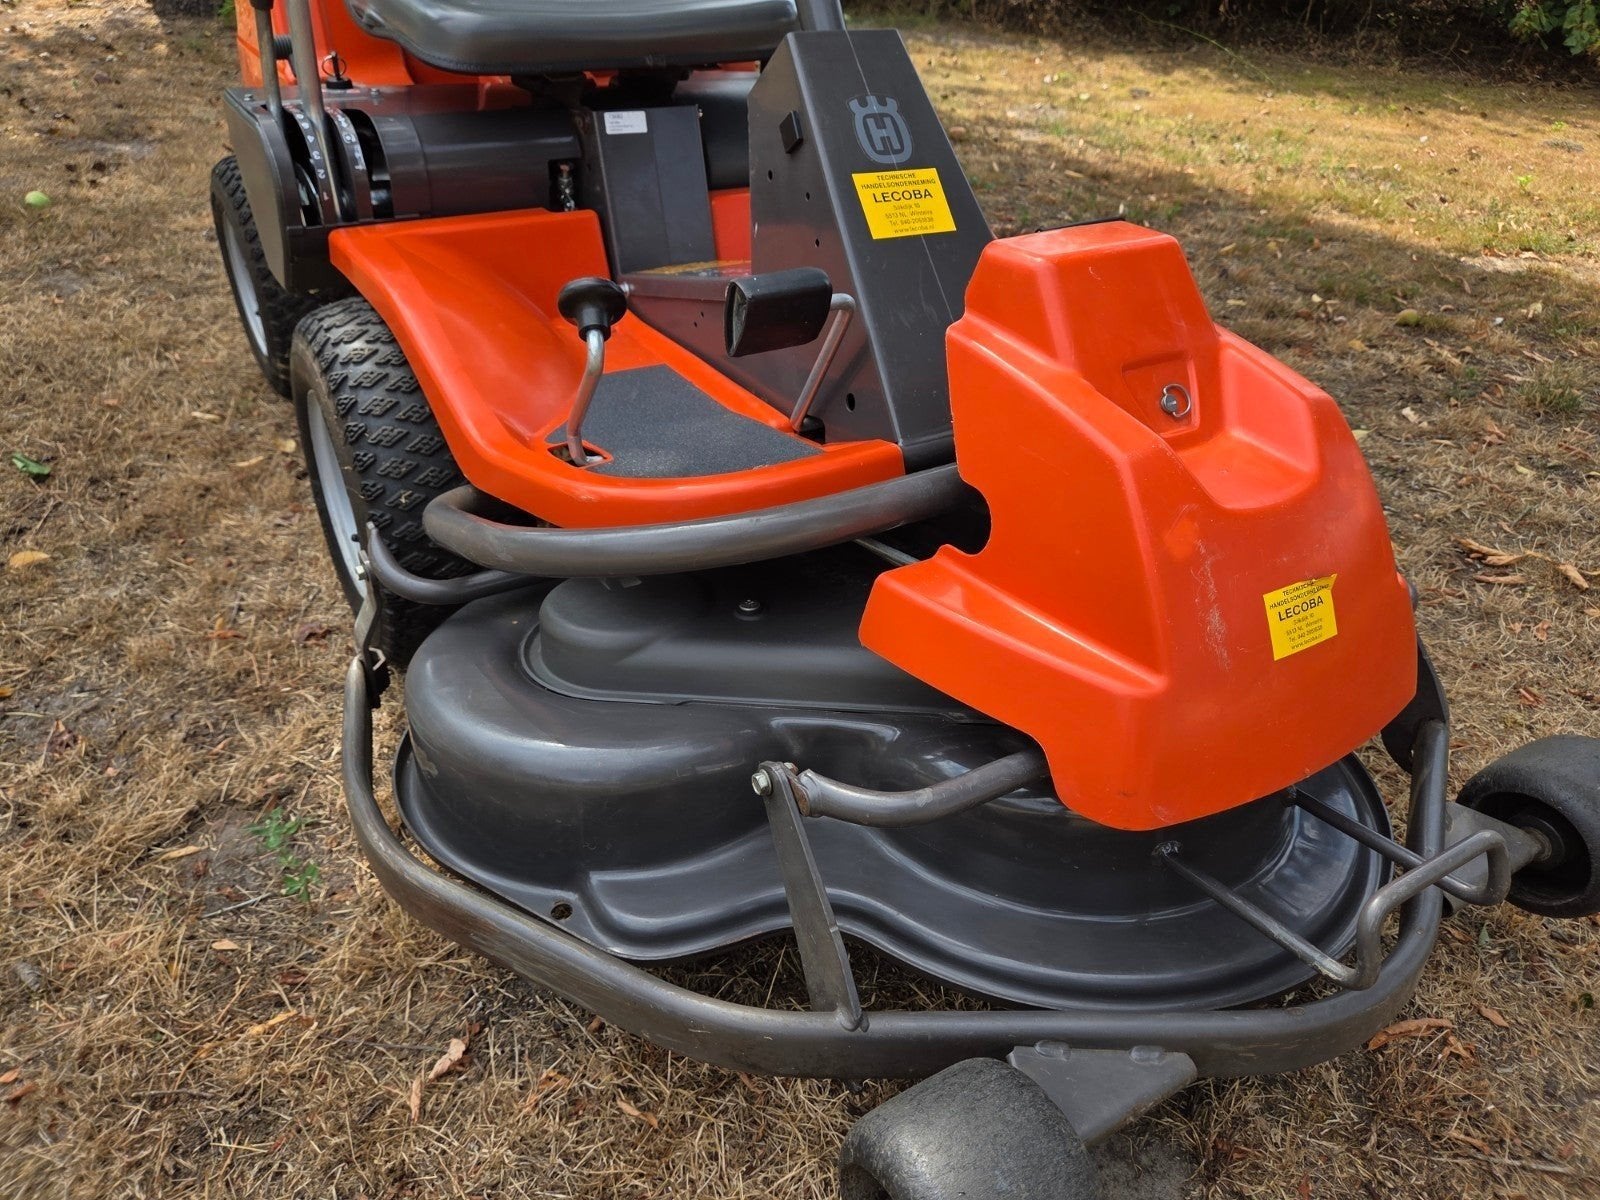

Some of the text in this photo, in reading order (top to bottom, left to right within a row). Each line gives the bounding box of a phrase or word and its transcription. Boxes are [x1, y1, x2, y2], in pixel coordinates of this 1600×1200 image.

[876, 173, 916, 181] TECHNISCHE
[861, 179, 936, 190] HANDELSONDERNEMING
[873, 189, 933, 203] LECOBA
[1278, 595, 1324, 621] LECOBA
